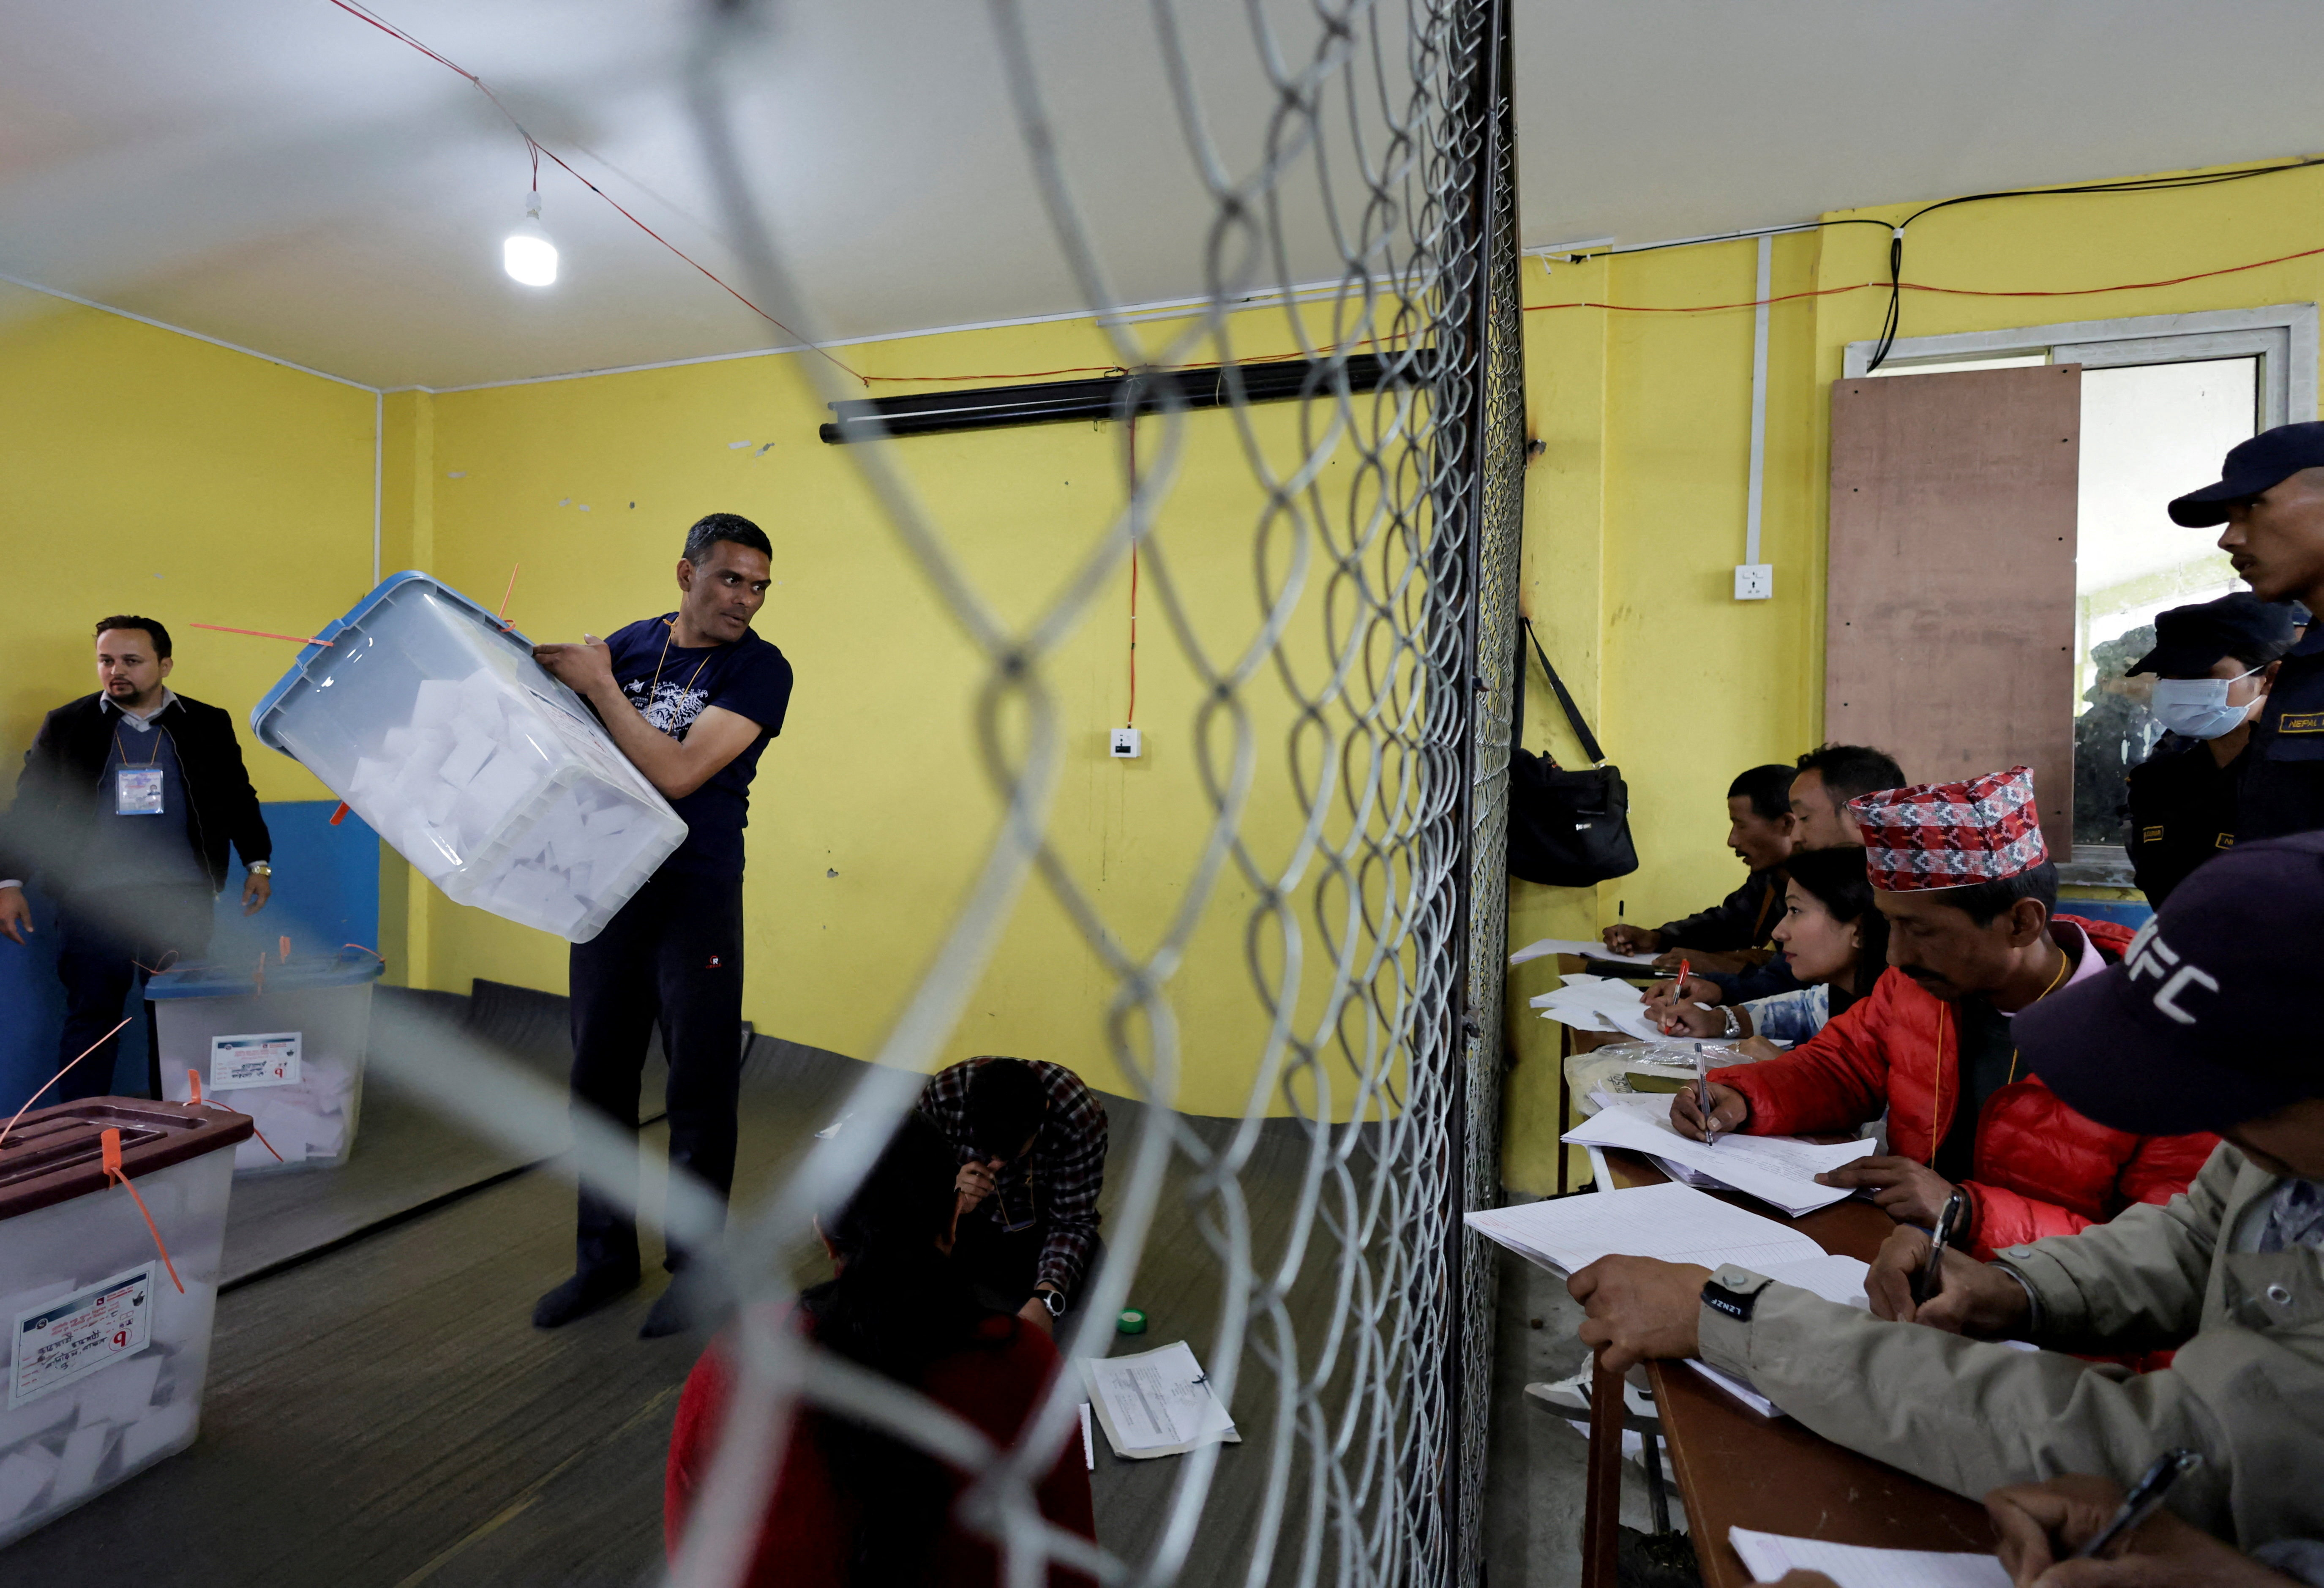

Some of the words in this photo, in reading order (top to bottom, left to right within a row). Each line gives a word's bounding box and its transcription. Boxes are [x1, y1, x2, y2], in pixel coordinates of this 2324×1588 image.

[2288, 719, 2317, 728] NEPAL
[1711, 1299, 1741, 1315] LZNZF
[113, 1331, 126, 1347] १
